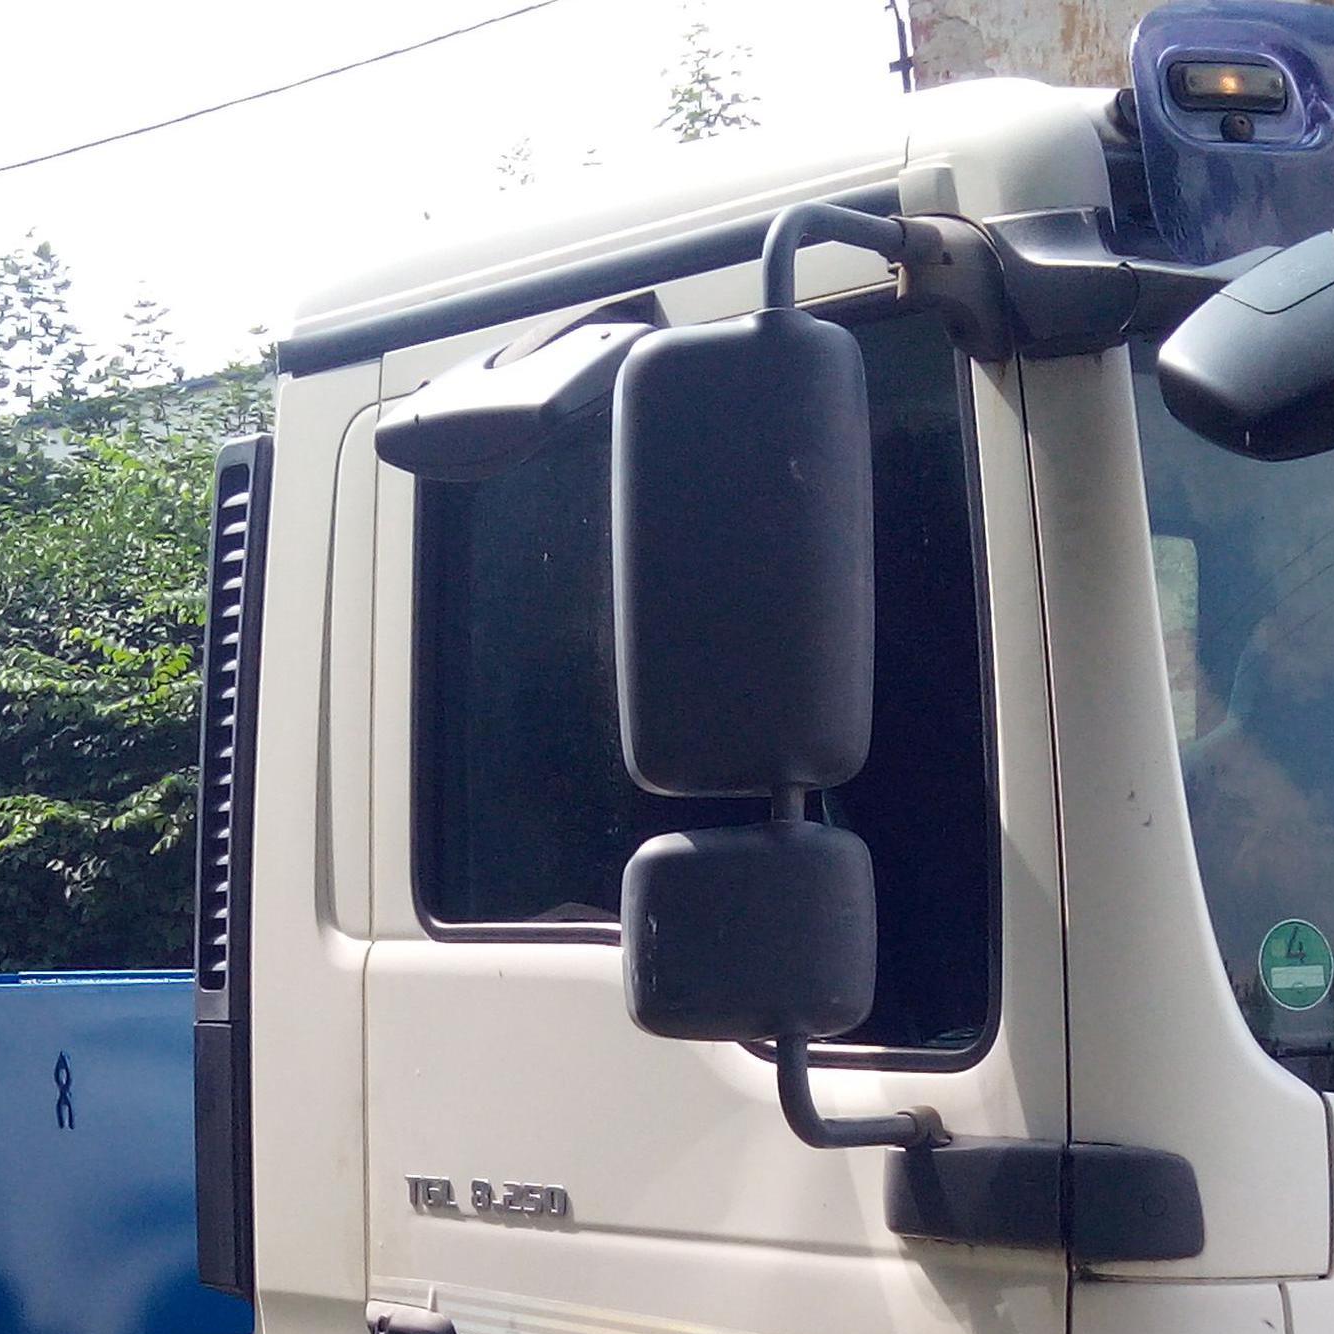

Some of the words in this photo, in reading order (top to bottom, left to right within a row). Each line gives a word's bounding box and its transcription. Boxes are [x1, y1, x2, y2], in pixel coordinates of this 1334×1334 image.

[1286, 926, 1306, 963] 4
[405, 1174, 458, 1207] TGL
[471, 1178, 568, 1216] 8.250
